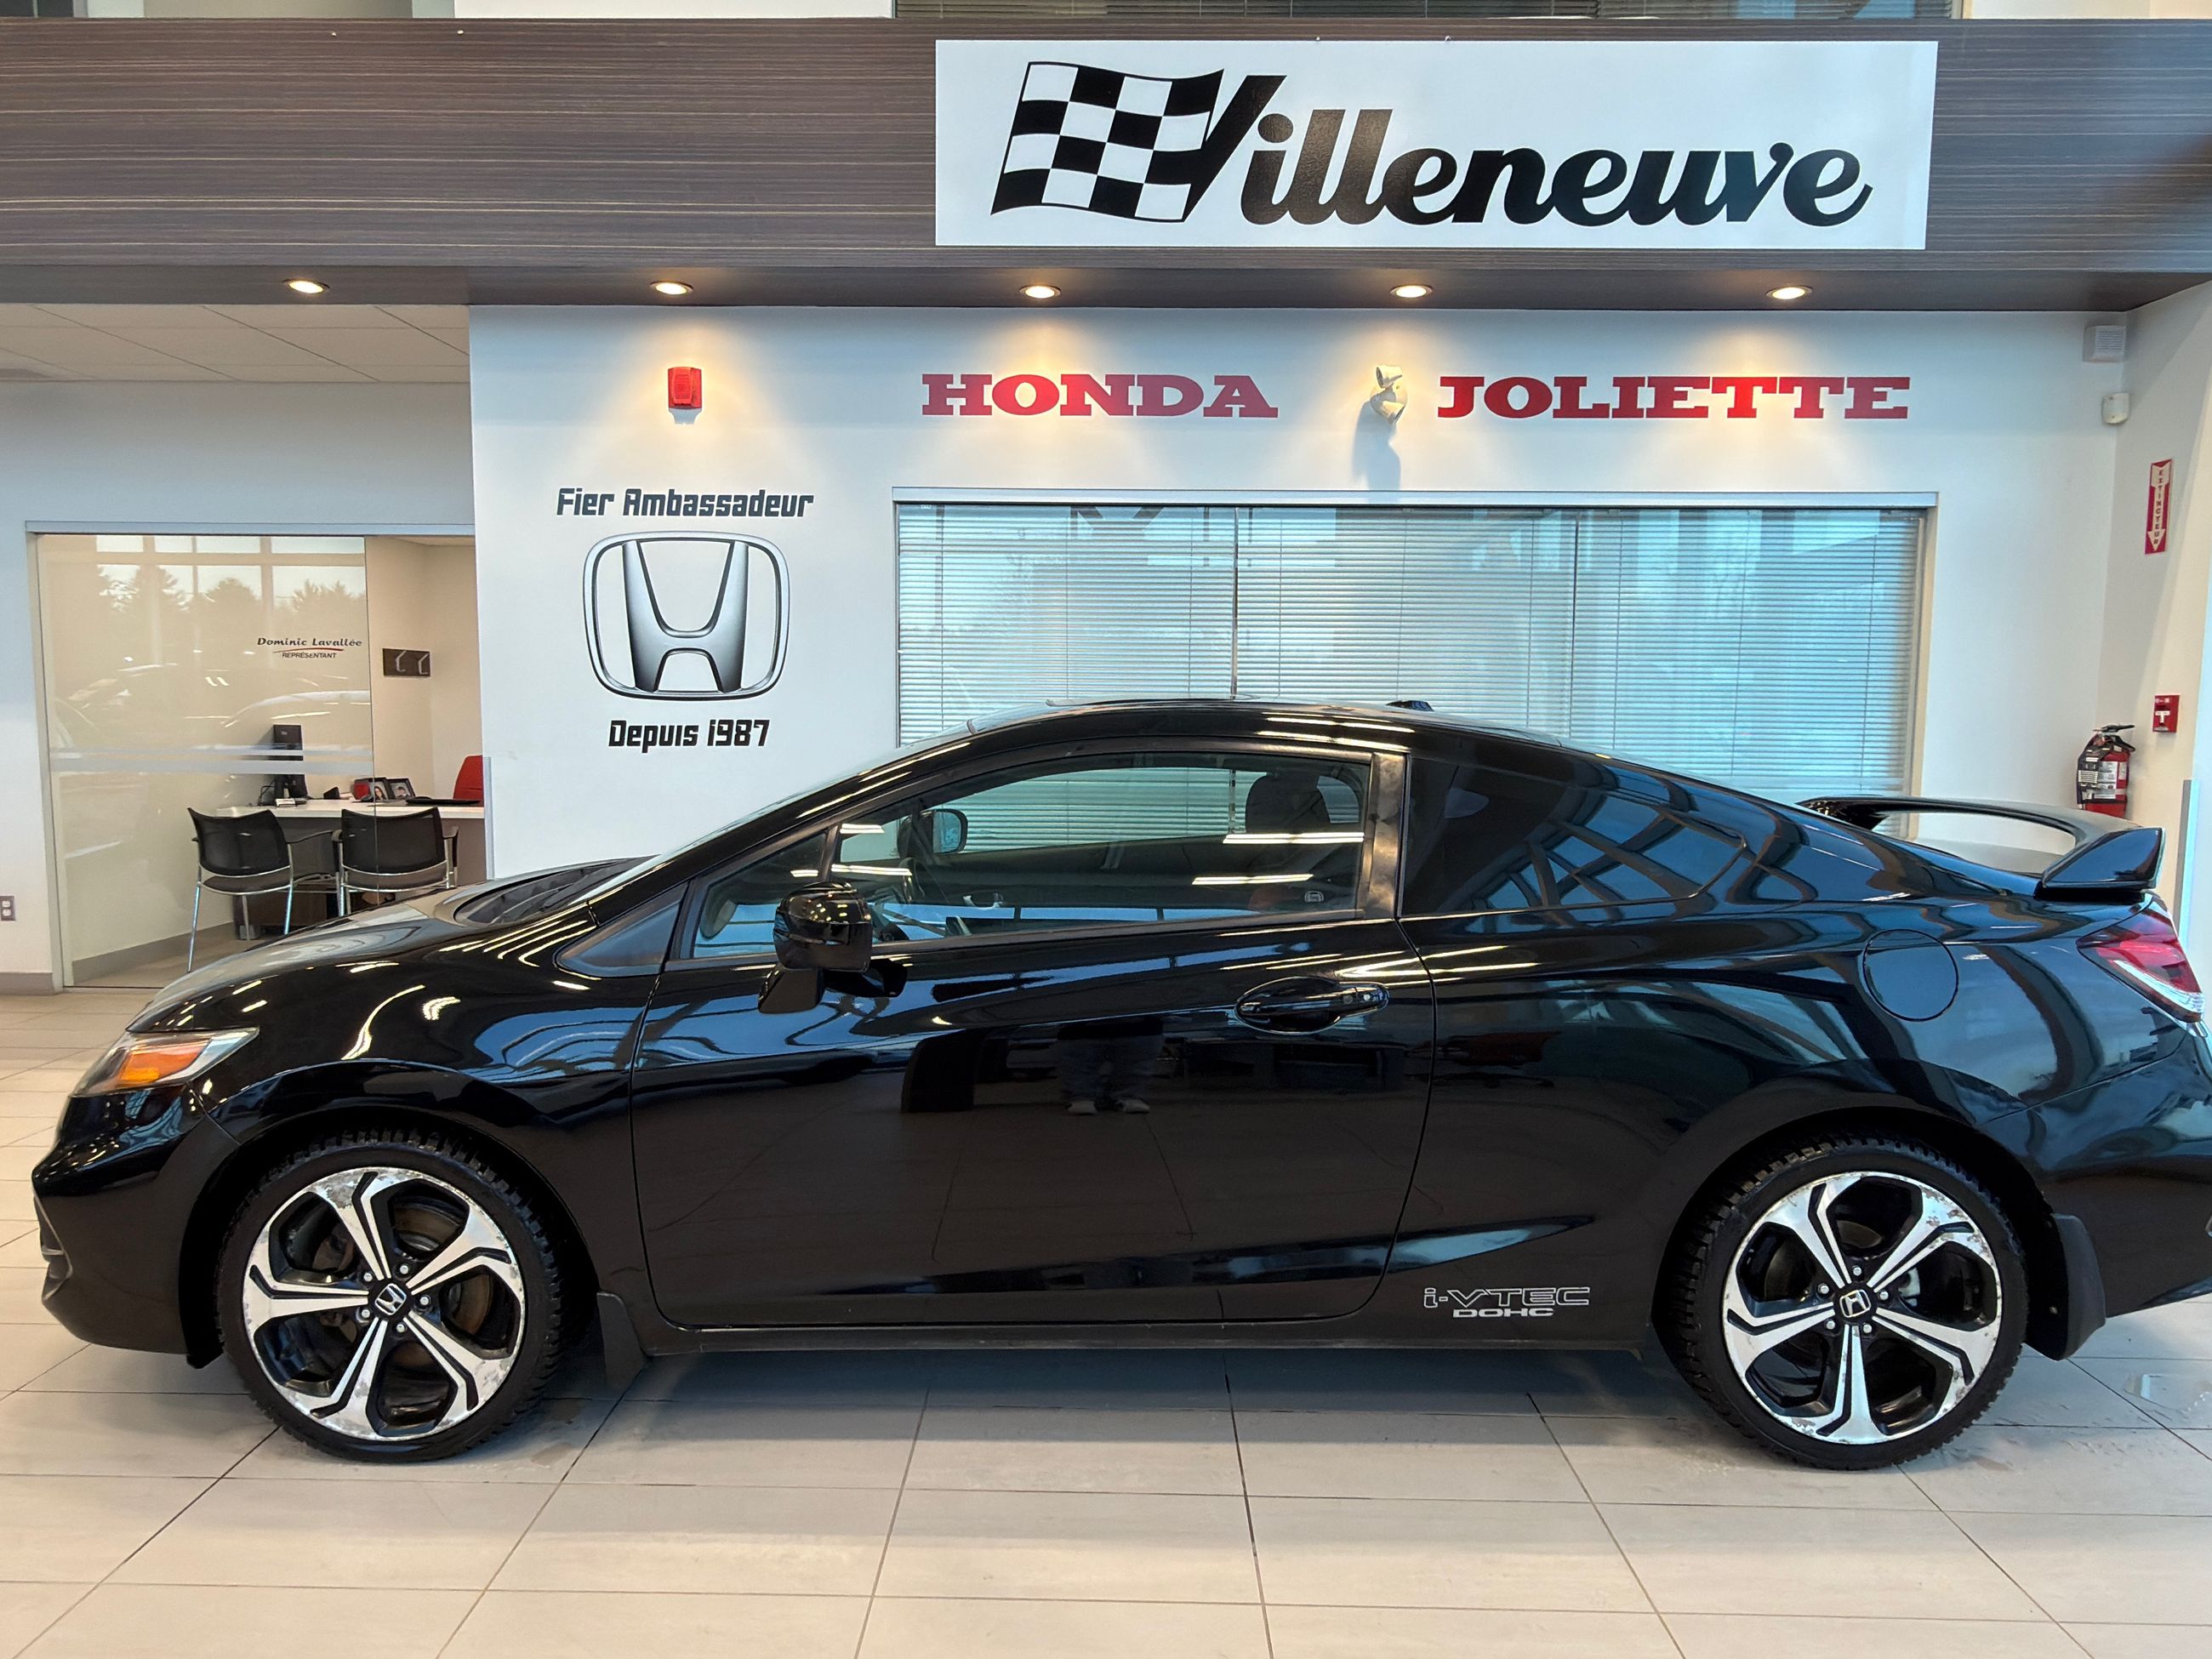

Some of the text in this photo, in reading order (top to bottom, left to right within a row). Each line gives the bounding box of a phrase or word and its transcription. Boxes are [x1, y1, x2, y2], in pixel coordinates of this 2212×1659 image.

[1183, 74, 1873, 227] Villeneuve
[921, 373, 1910, 419] HONDA JOLIETTE
[556, 487, 814, 517] Fier Ambassadeur
[257, 637, 362, 647] Dominic Lavallée
[608, 719, 770, 754] Depuis 1987
[1423, 1286, 1591, 1308] i-VTEC
[1452, 1308, 1554, 1319] DOHC
